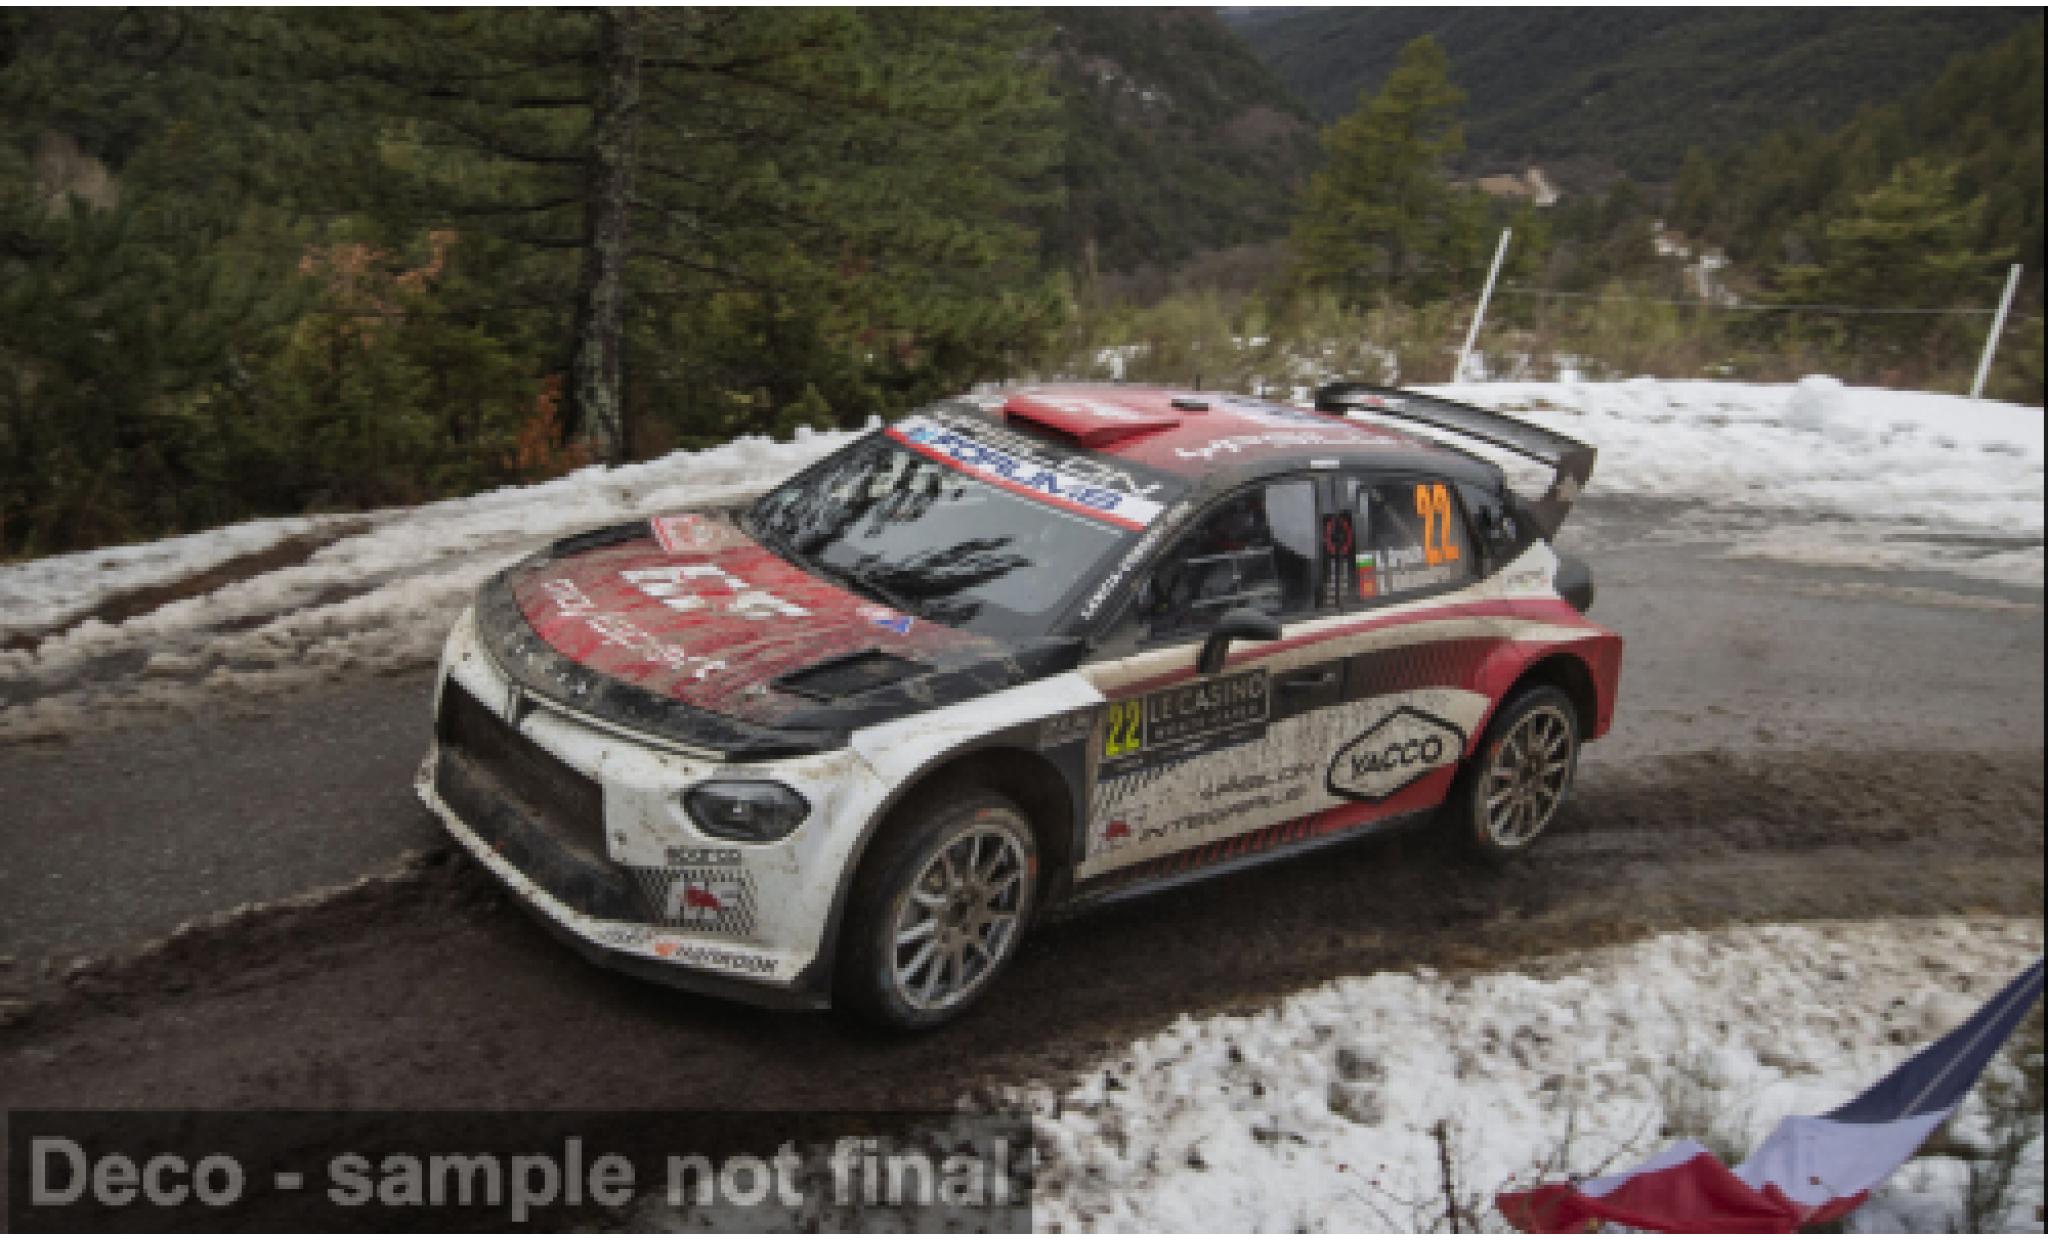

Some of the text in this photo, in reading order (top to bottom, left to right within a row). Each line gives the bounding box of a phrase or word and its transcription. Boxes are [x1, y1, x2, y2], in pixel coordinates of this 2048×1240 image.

[1414, 480, 1460, 566] 22
[1149, 695, 1174, 723] LE
[1179, 670, 1266, 715] CASINO
[1105, 699, 1141, 757] 22
[1351, 735, 1443, 780] YACCO
